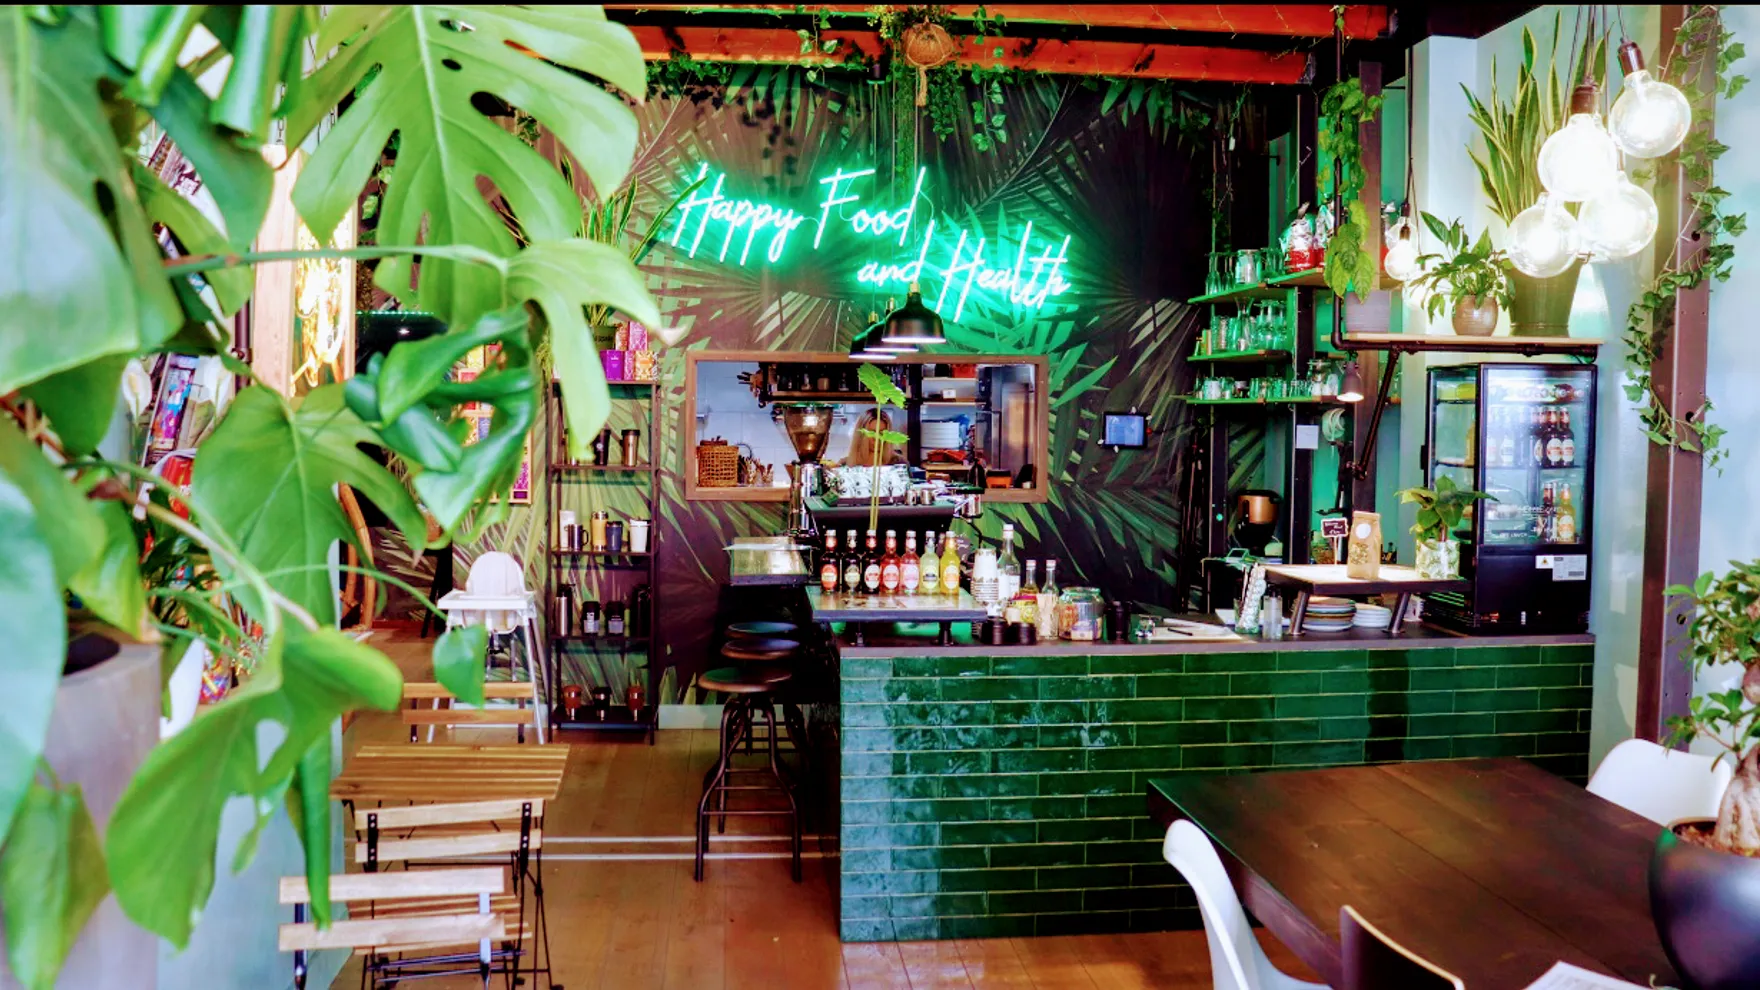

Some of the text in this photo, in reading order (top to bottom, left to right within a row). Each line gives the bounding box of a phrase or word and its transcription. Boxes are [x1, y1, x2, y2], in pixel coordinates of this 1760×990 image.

[670, 161, 927, 266] Happy Food
[857, 219, 1071, 323] and Health
